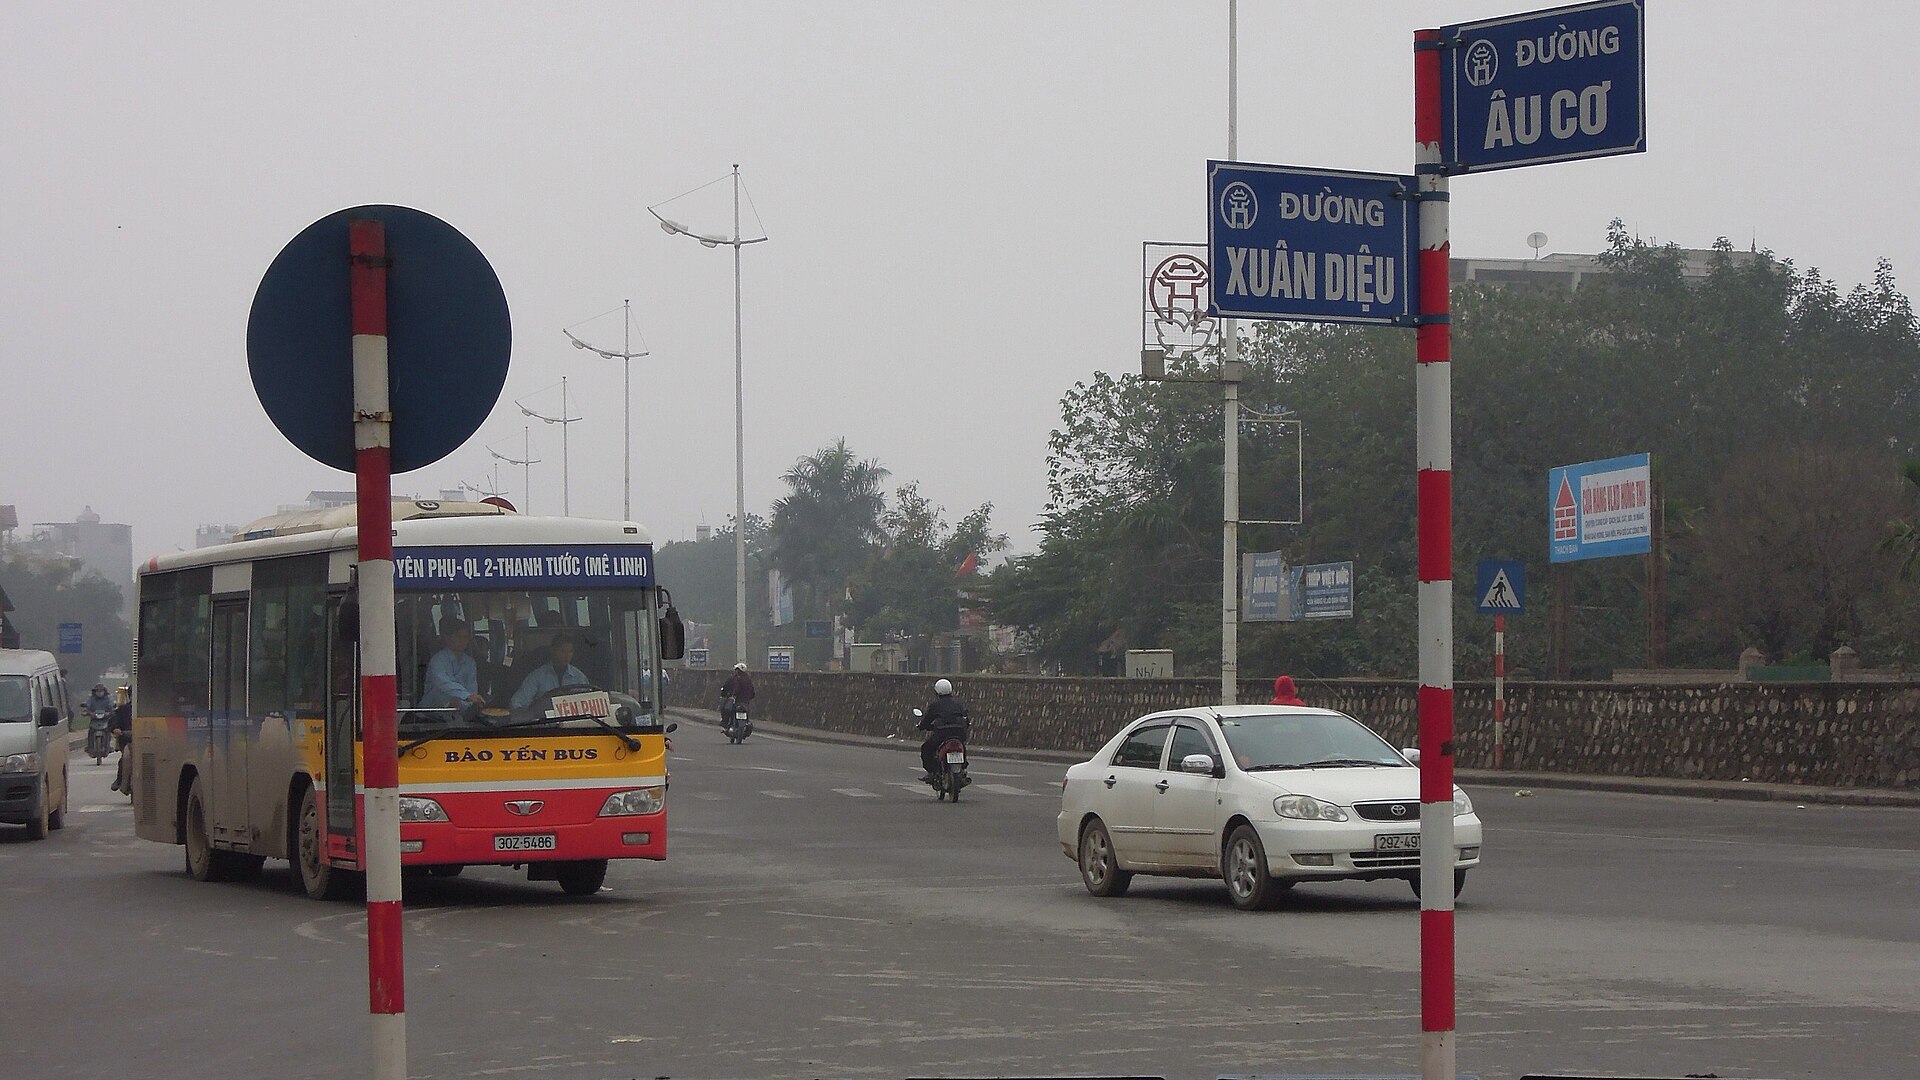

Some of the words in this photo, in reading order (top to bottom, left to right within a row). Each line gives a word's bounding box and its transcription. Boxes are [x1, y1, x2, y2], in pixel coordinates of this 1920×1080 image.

[1515, 24, 1620, 67] ĐƯỜNG
[1484, 88, 1541, 149] ÂU
[1550, 80, 1611, 139] CƠ
[1279, 186, 1384, 227] ĐƯỜNG
[1225, 239, 1315, 300] XUÂN
[1325, 244, 1394, 312] DIỆU
[396, 555, 424, 578] YÊN
[546, 552, 581, 576] TƯỚC
[585, 554, 610, 577] (MÊ
[614, 557, 647, 578] LINH)
[445, 747, 493, 763] BẢO
[500, 745, 546, 761] YẾN
[553, 749, 597, 761] BUS
